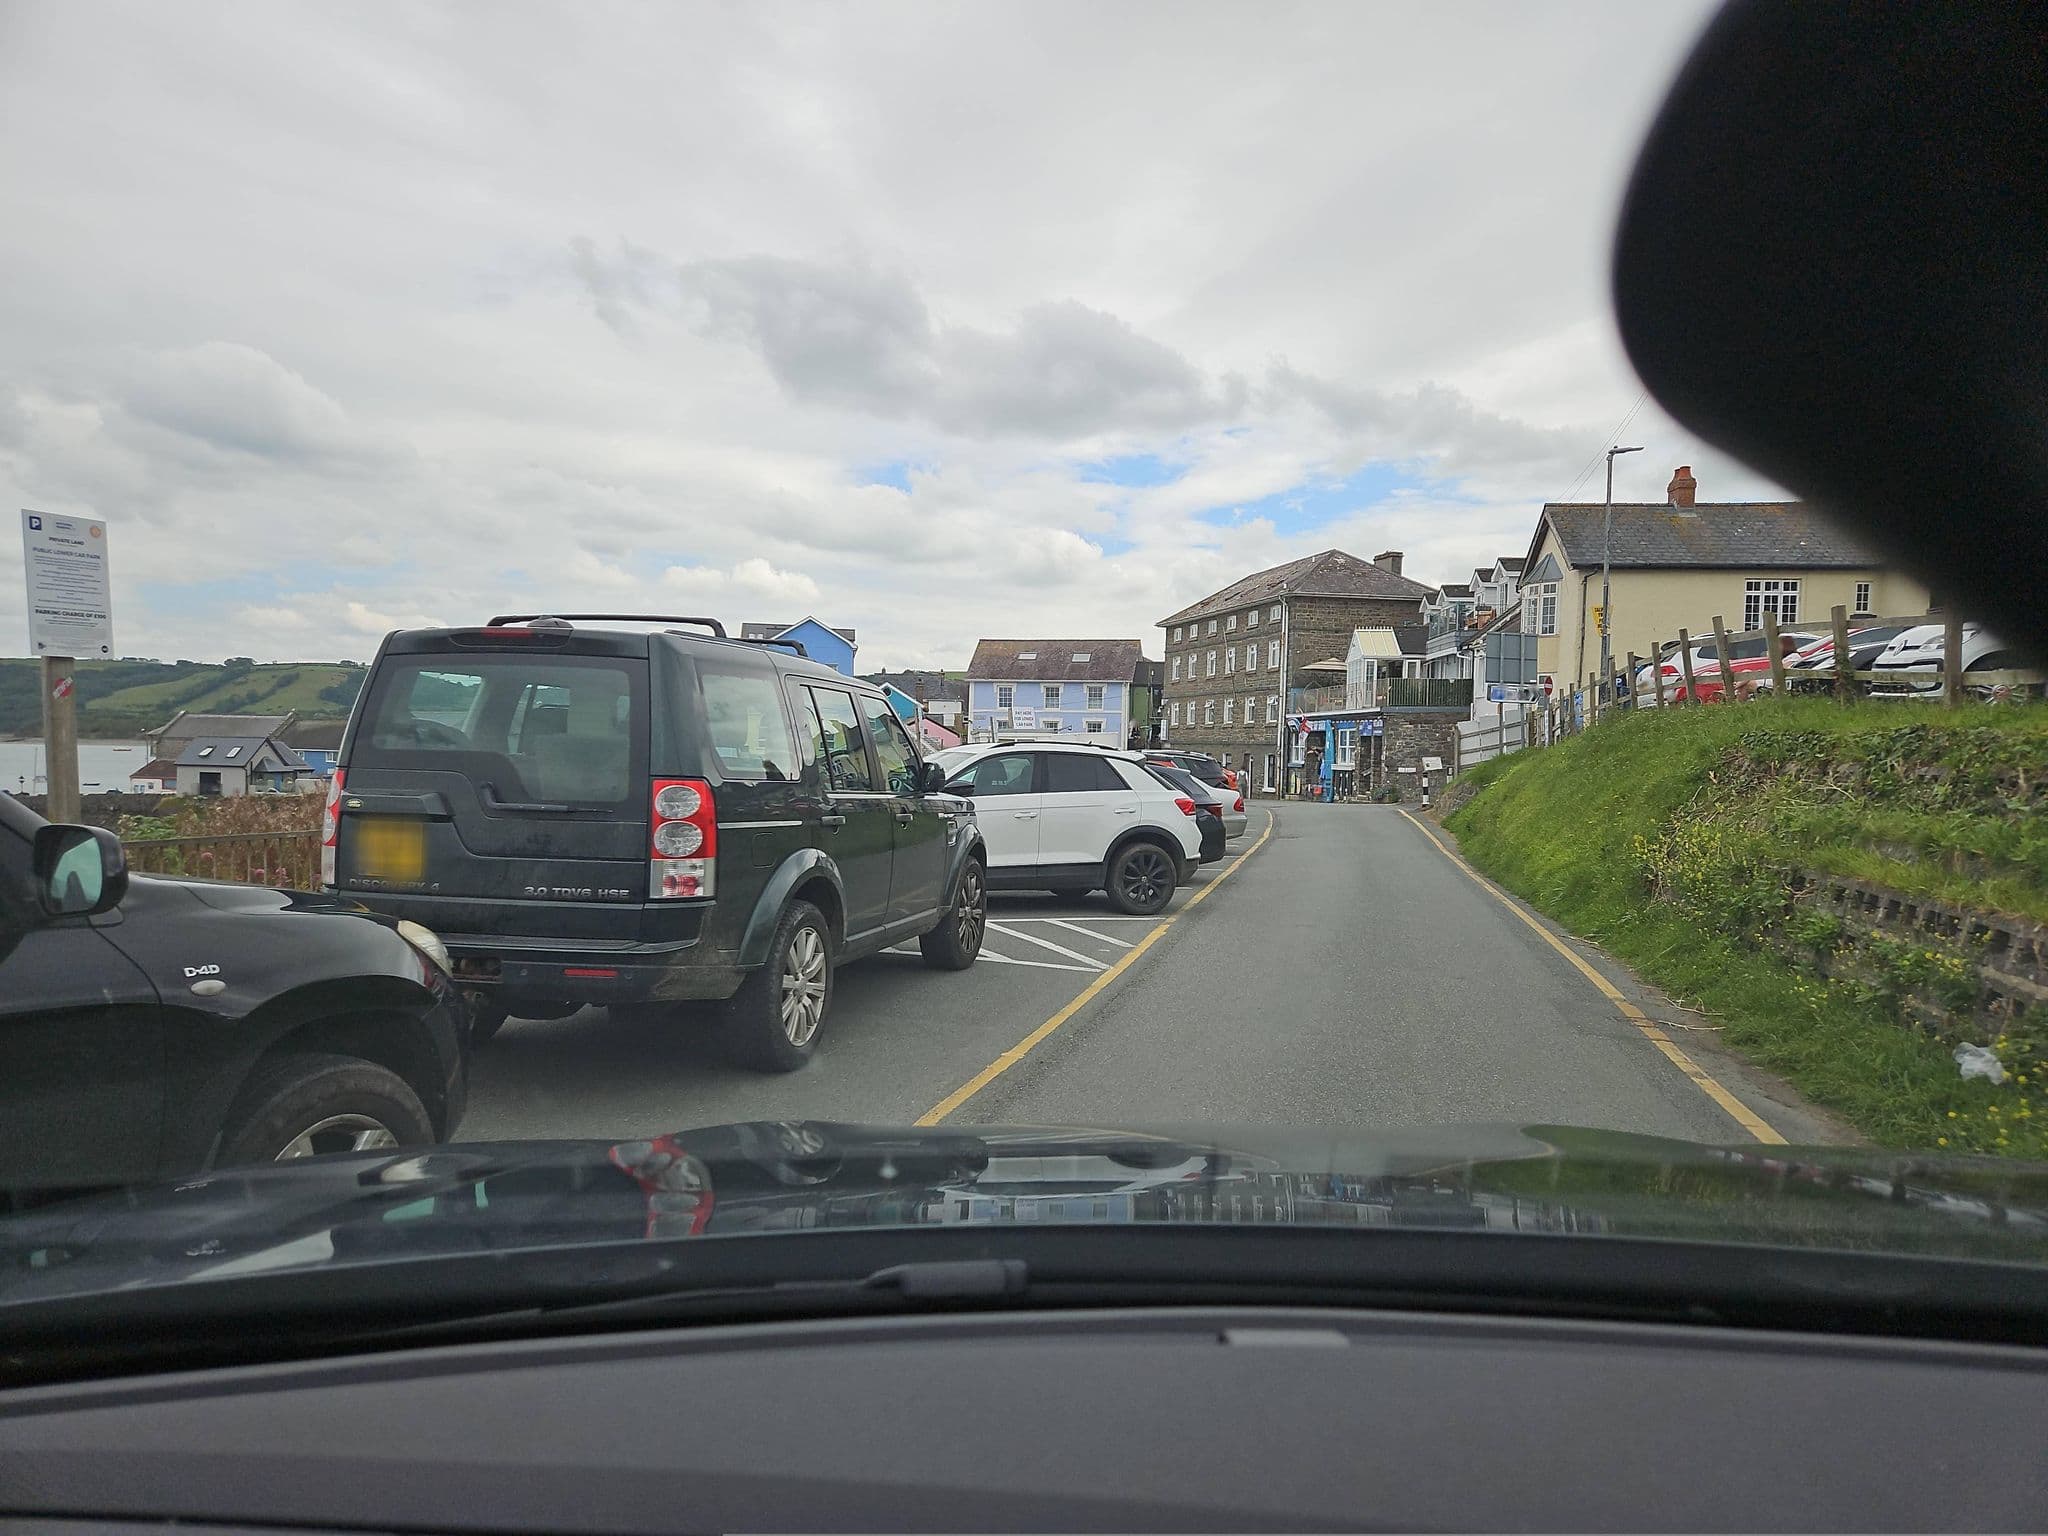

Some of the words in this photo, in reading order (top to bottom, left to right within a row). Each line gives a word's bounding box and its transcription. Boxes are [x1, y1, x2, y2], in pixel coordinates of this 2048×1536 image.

[524, 885, 548, 896] 3.0
[551, 886, 593, 897] TDV6
[597, 887, 630, 898] HSE
